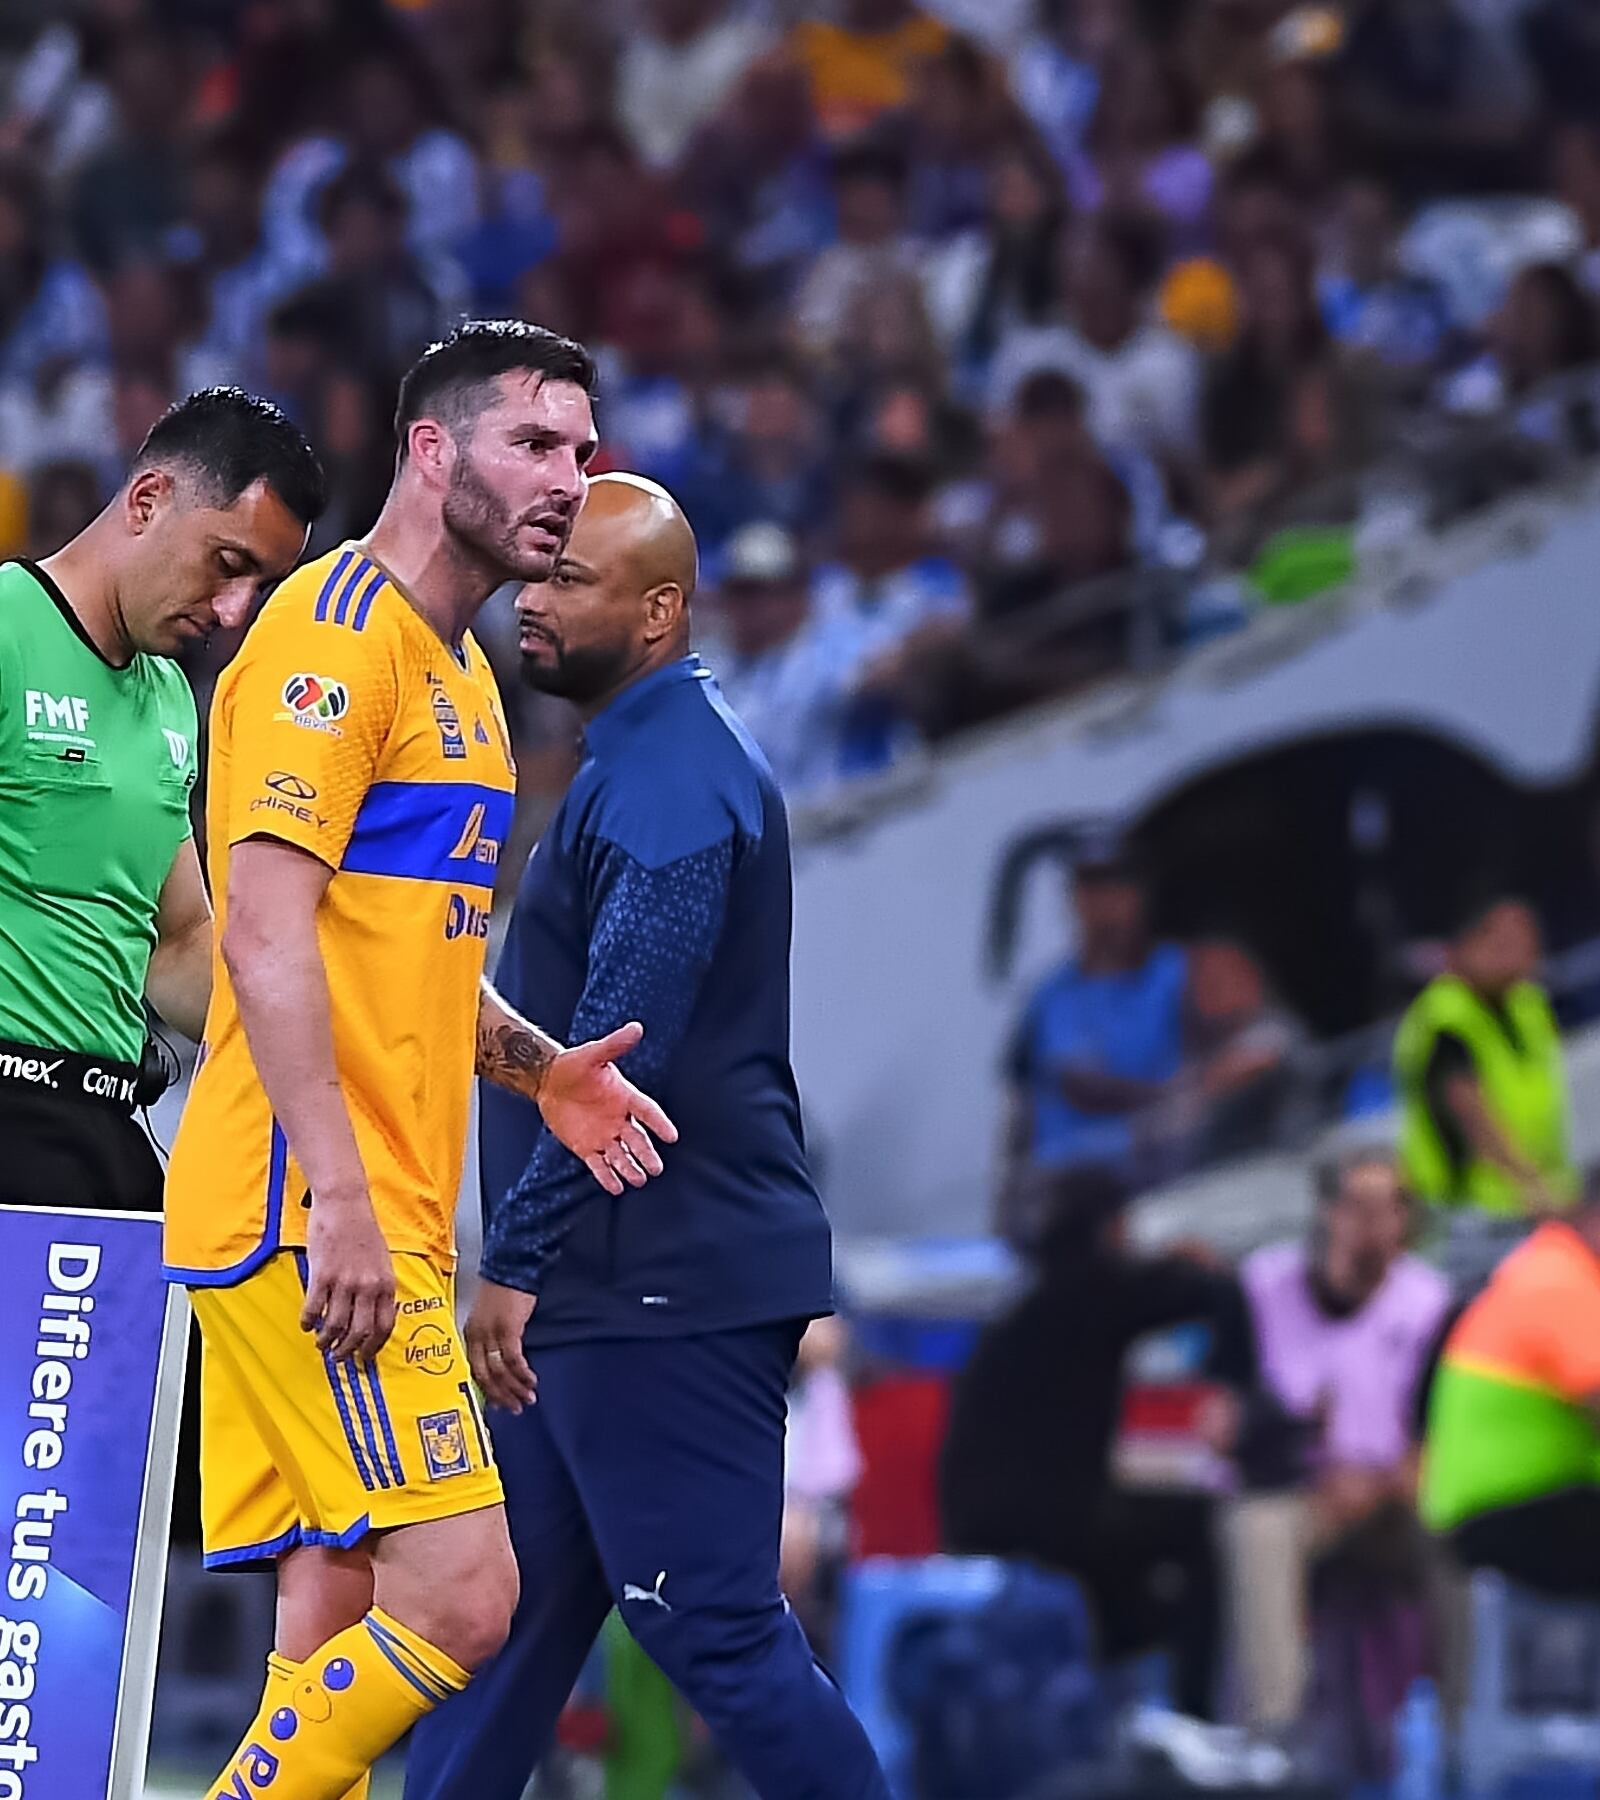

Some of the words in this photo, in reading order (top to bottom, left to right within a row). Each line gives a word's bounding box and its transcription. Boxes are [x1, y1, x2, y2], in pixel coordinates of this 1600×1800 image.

[25, 689, 90, 732] FMF
[250, 796, 329, 829] CHIREY
[402, 1297, 444, 1315] CEMEX
[22, 1242, 102, 1470] Difiere
[405, 1342, 452, 1364] Vertua
[7, 1489, 68, 1600] tus
